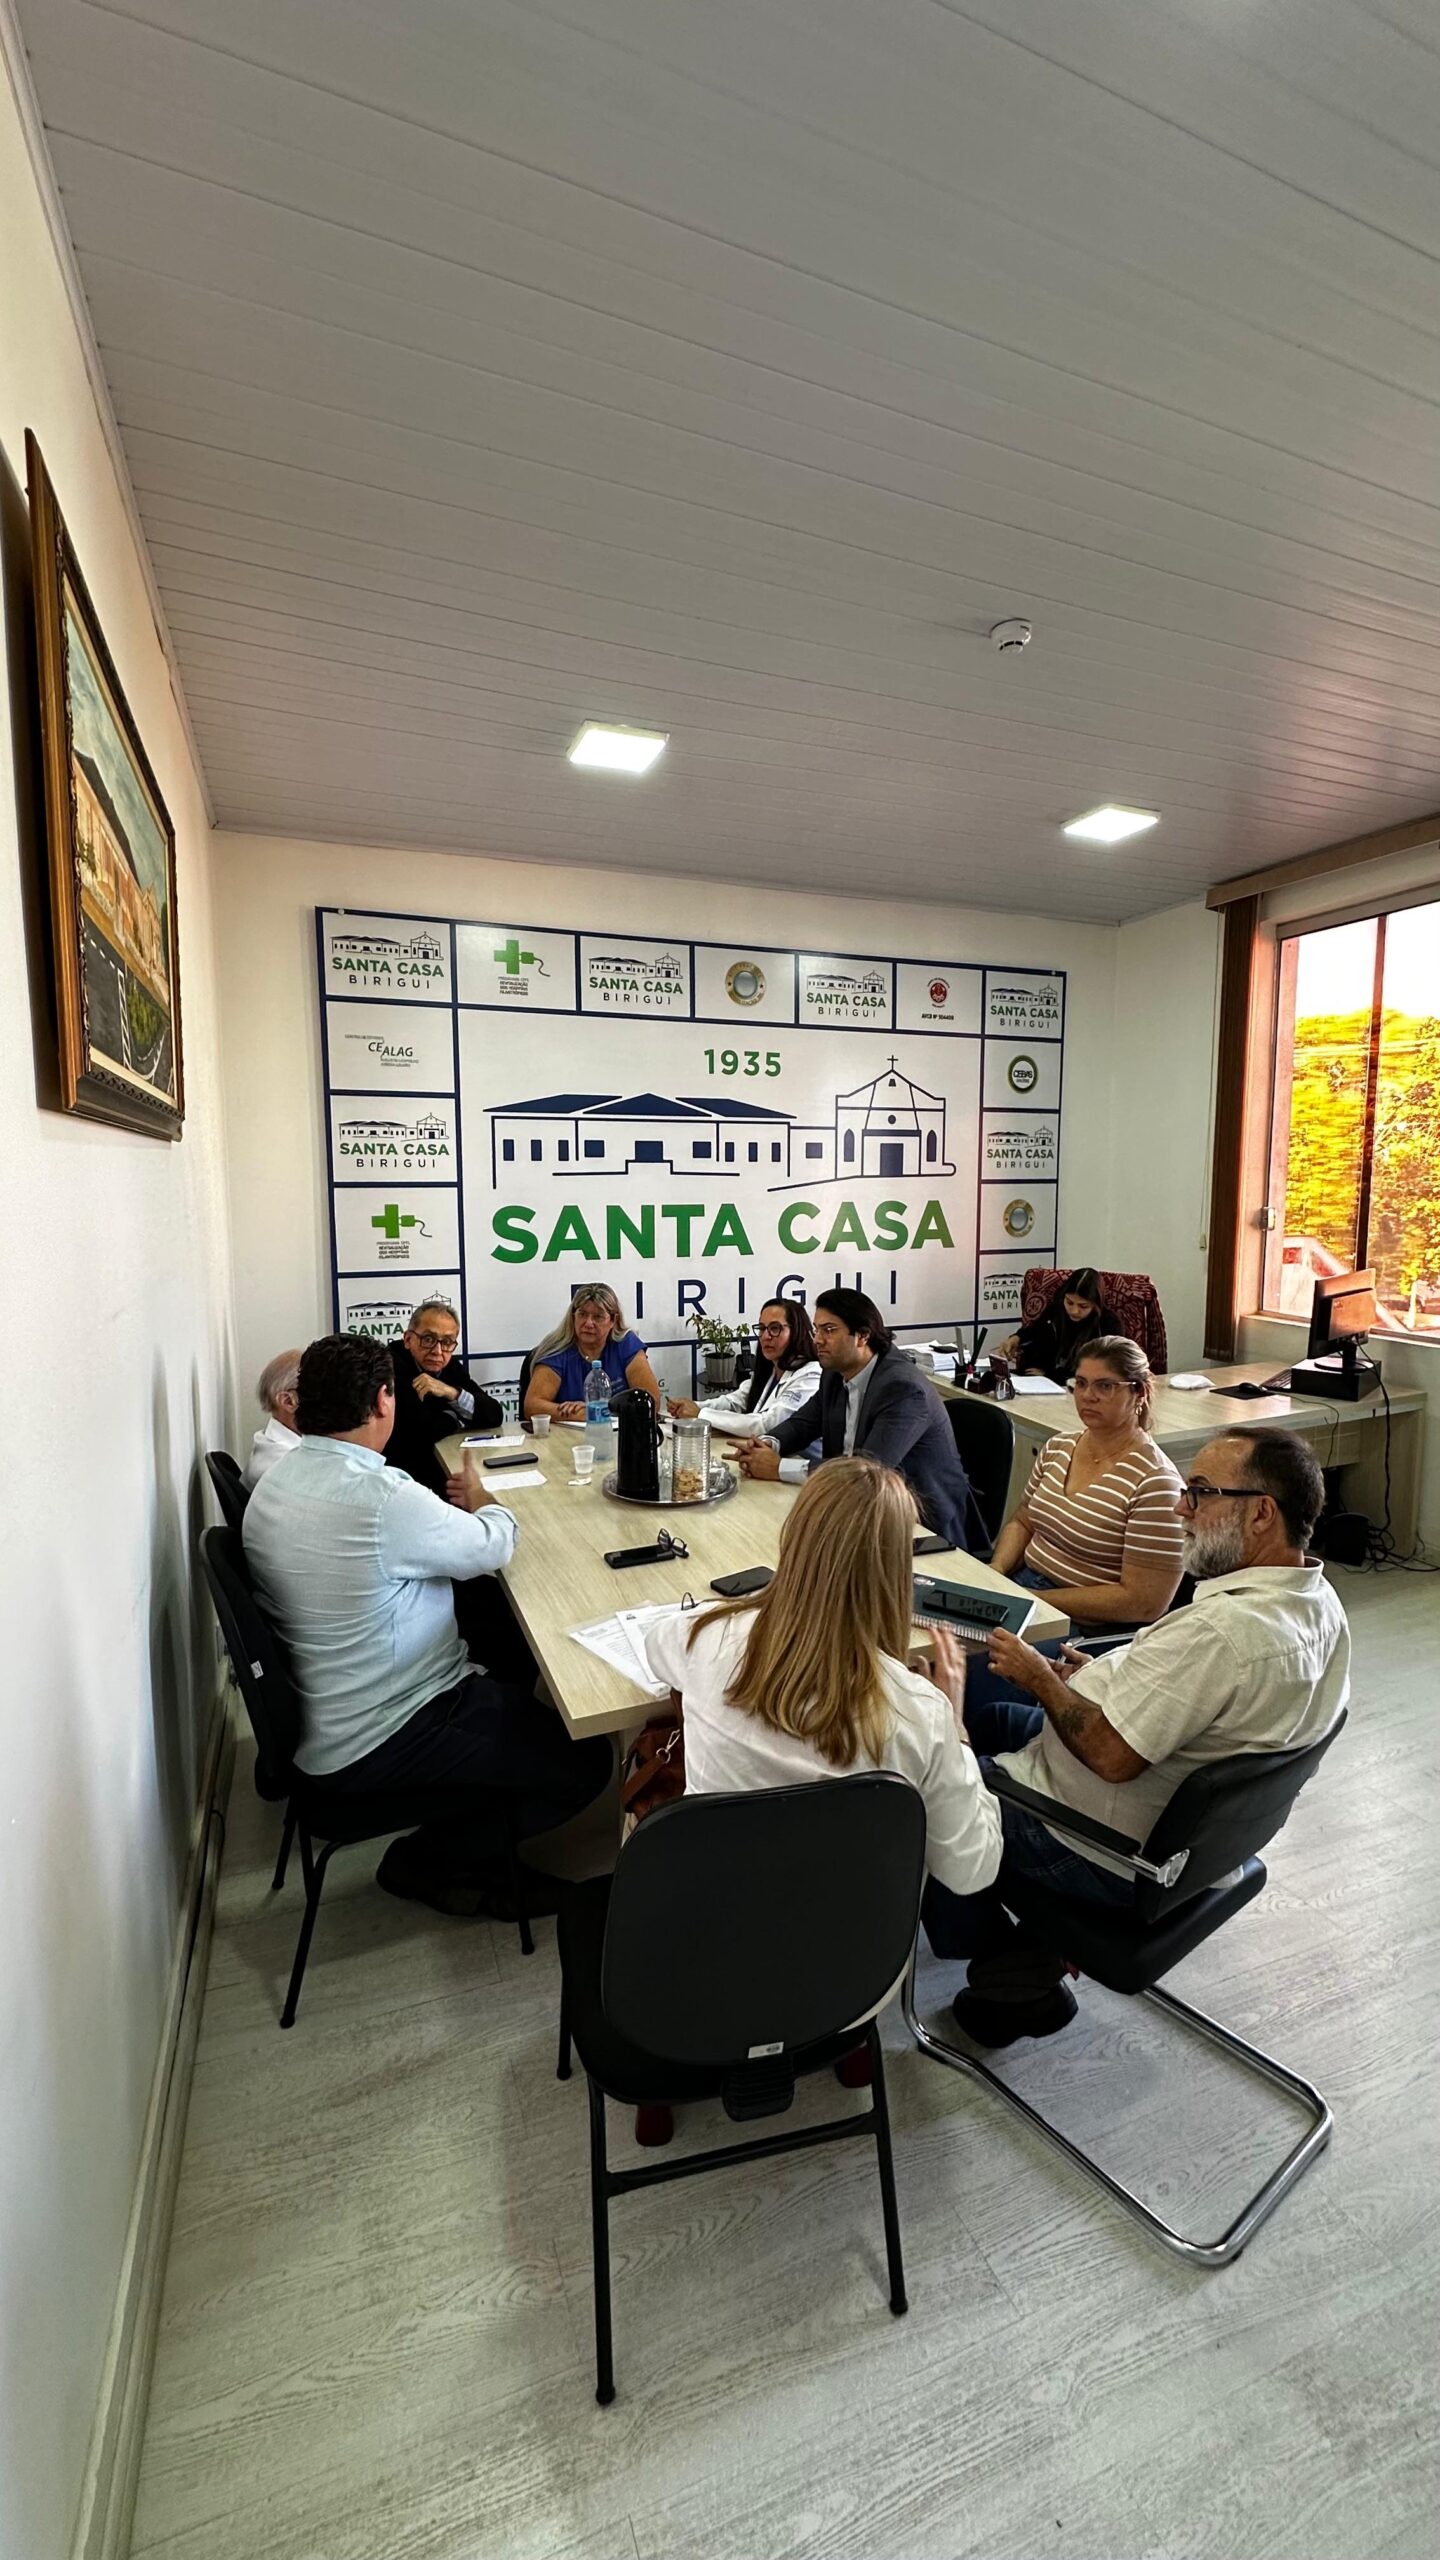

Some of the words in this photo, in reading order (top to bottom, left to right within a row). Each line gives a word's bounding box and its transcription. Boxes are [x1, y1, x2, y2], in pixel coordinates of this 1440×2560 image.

[332, 957, 391, 973] SANTA
[397, 962, 444, 977] CASA
[349, 974, 430, 989] BIRIGUI
[589, 976, 639, 991] SANTA
[643, 981, 683, 994] CASA
[603, 992, 671, 1005] BIRIGUI
[806, 992, 849, 1005] SANTA
[852, 996, 886, 1008] CASA
[818, 1007, 875, 1018] BIRIGUI
[990, 1005, 1027, 1017] SANTA
[1030, 1008, 1058, 1020] CASA
[1000, 1018, 1049, 1029] BIRIGUI
[368, 1042, 413, 1057] CEALAG
[704, 1049, 781, 1077] 1935
[339, 1142, 398, 1155] SANTA
[403, 1143, 450, 1156] CASA
[987, 1149, 1022, 1159] SANTA
[1025, 1149, 1054, 1159] CASA
[356, 1159, 435, 1168] BIRIGUI
[490, 1203, 754, 1264] SANTA
[778, 1200, 955, 1254] CASA
[984, 1290, 1018, 1301] SANTA
[992, 1302, 1018, 1310] BIRI
[347, 1323, 405, 1337] SANTA
